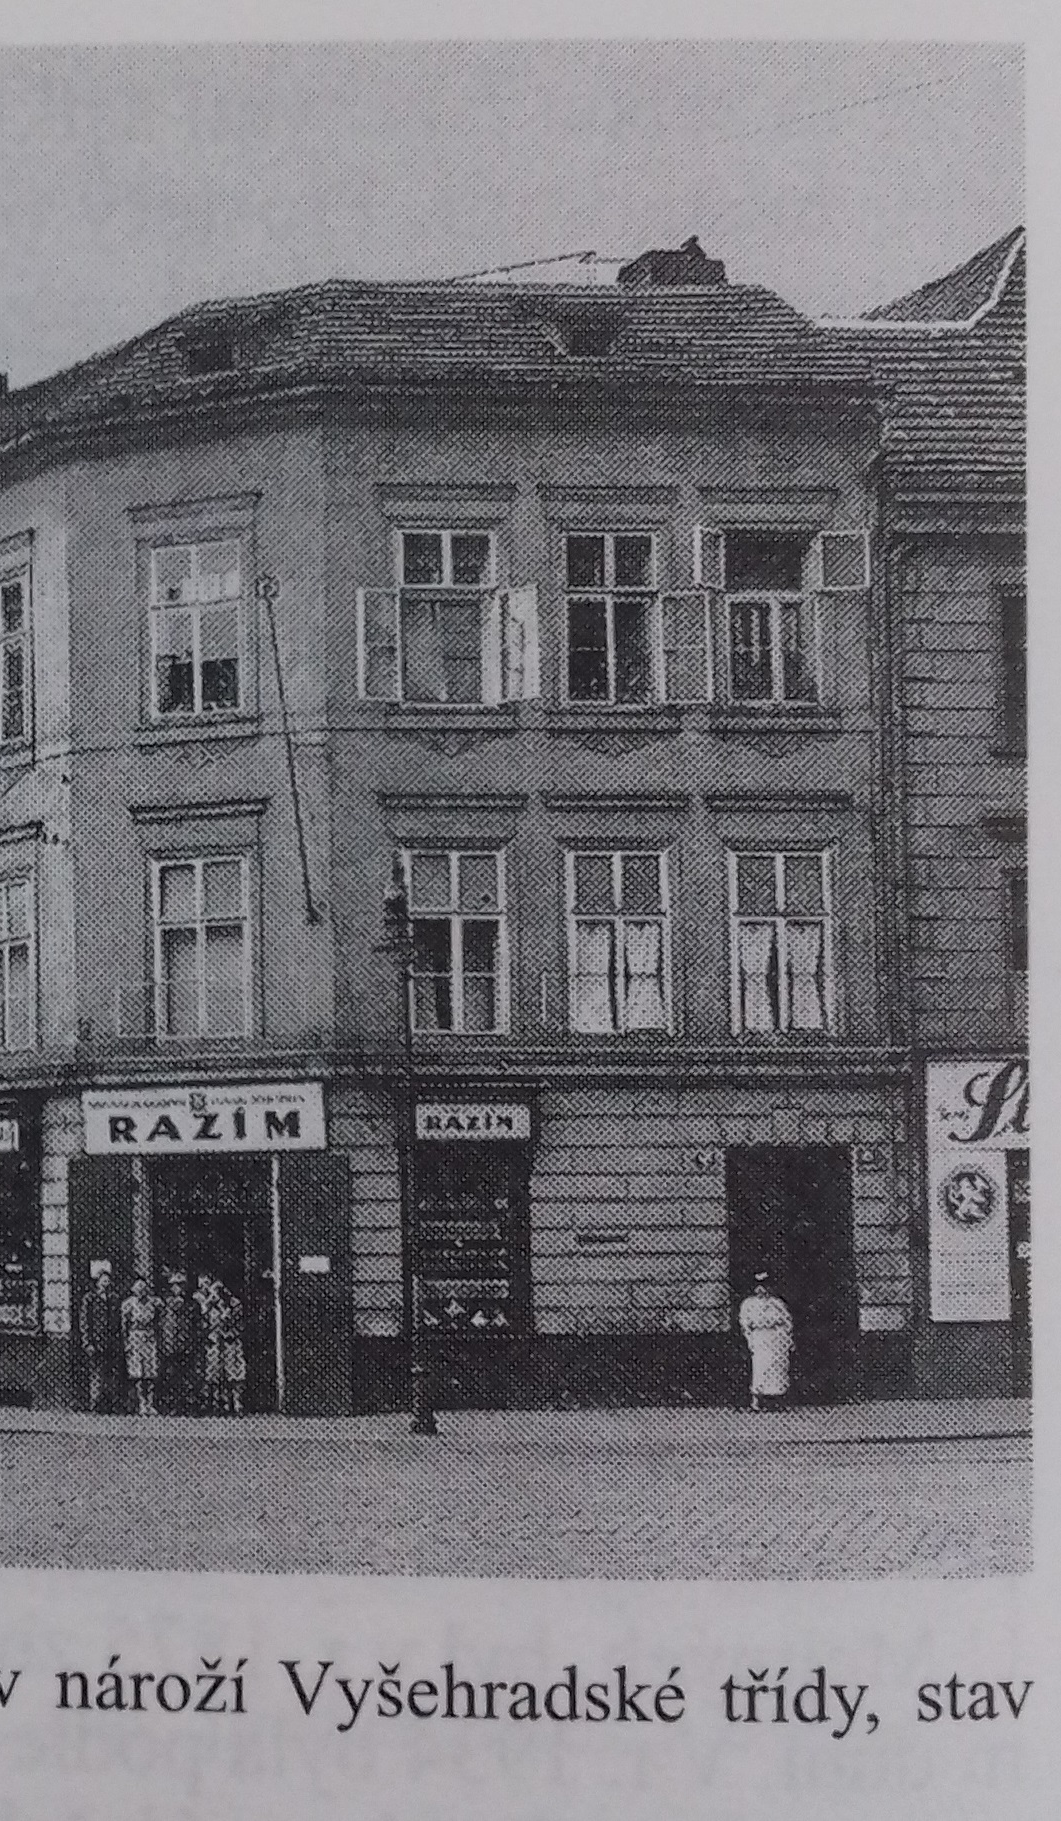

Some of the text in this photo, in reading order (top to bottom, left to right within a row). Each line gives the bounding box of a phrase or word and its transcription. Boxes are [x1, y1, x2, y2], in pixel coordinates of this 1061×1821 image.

[108, 1106, 301, 1144] RAZÍM
[54, 1654, 249, 1714] nároží
[277, 1660, 686, 1734] Vyšehradské
[719, 1666, 881, 1741] třídy,
[917, 1672, 1035, 1723] stav
